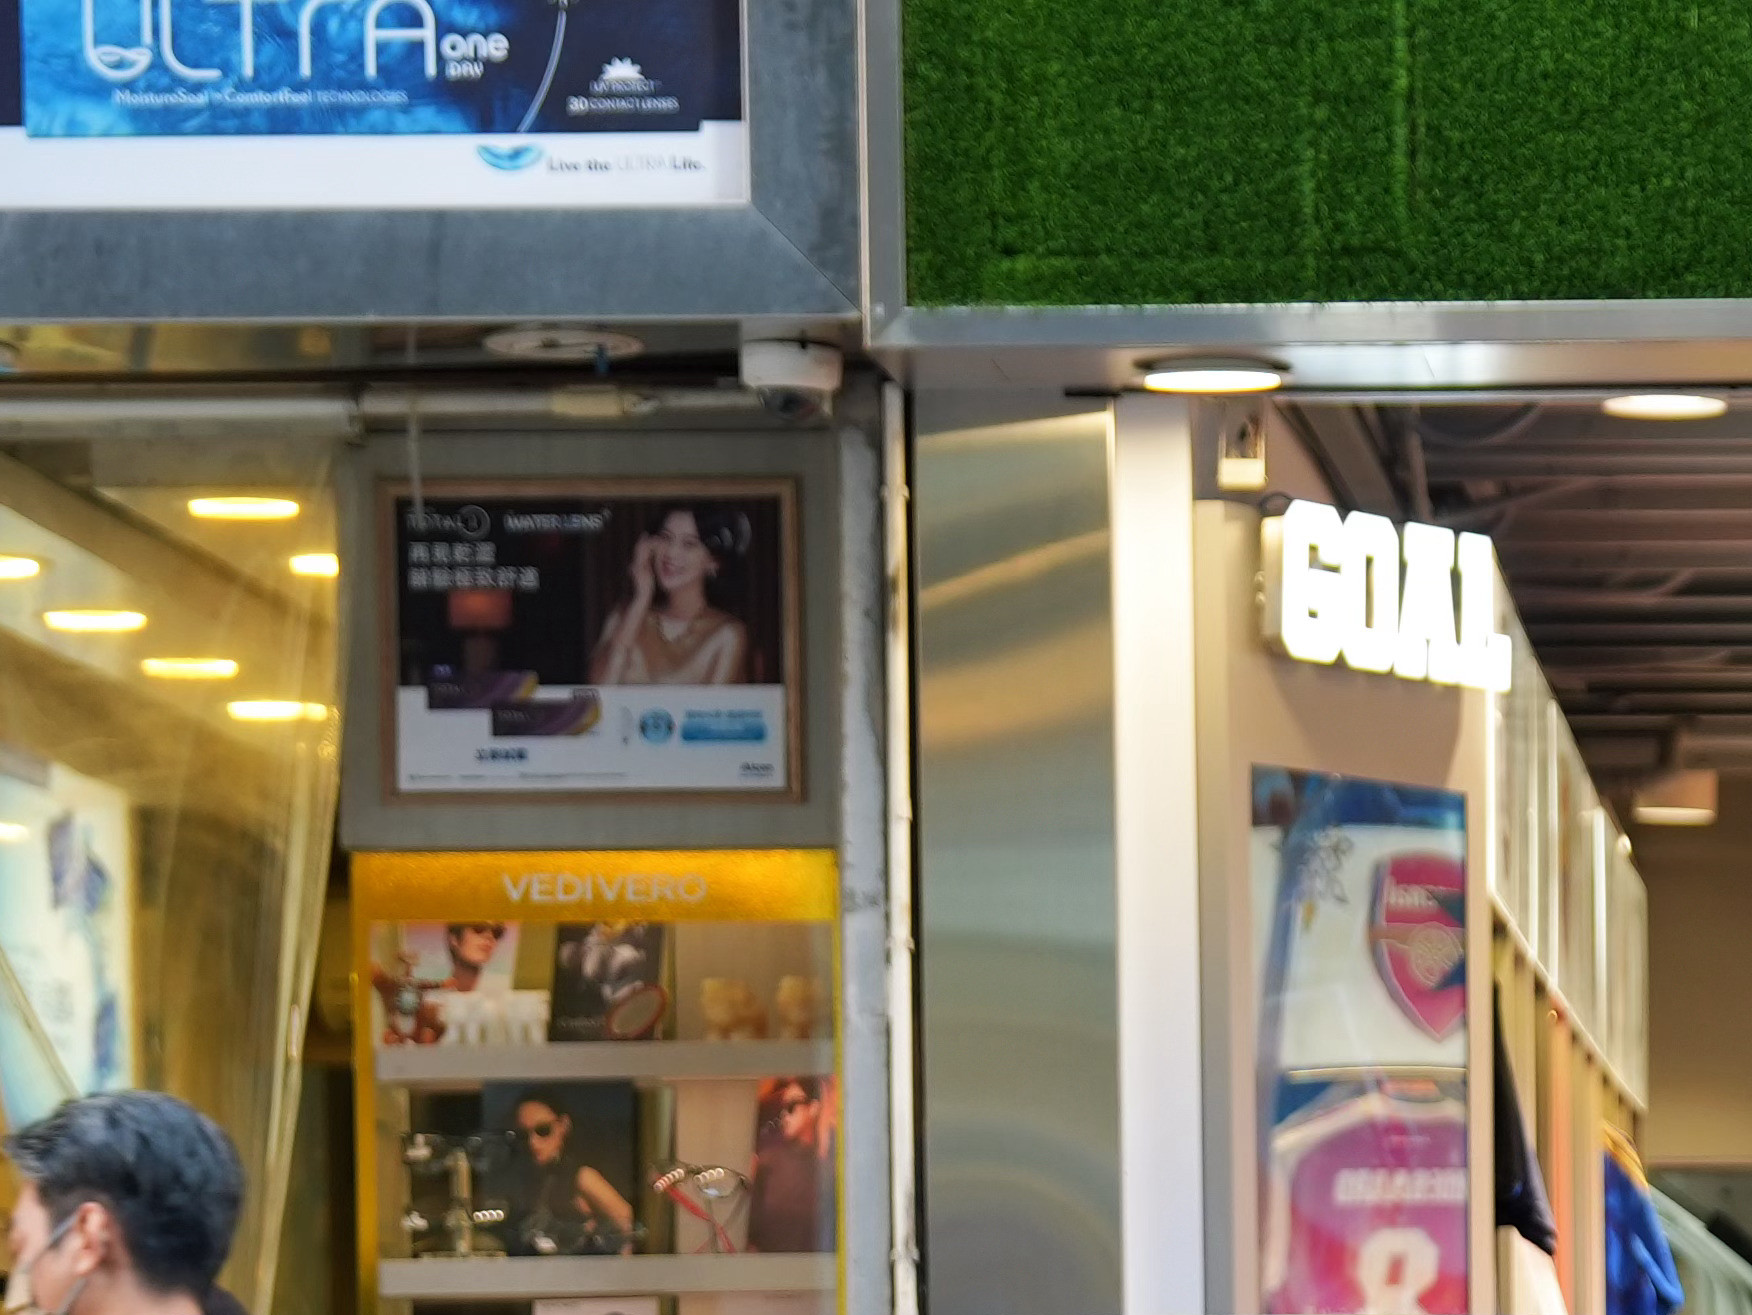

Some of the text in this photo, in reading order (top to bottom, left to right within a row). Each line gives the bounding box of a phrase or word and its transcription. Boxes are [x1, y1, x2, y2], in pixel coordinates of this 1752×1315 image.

[440, 31, 510, 62] one
[549, 156, 582, 171] Live
[588, 156, 612, 171] the
[1281, 499, 1513, 693] GOAL
[502, 871, 709, 904] VEDIVERO
